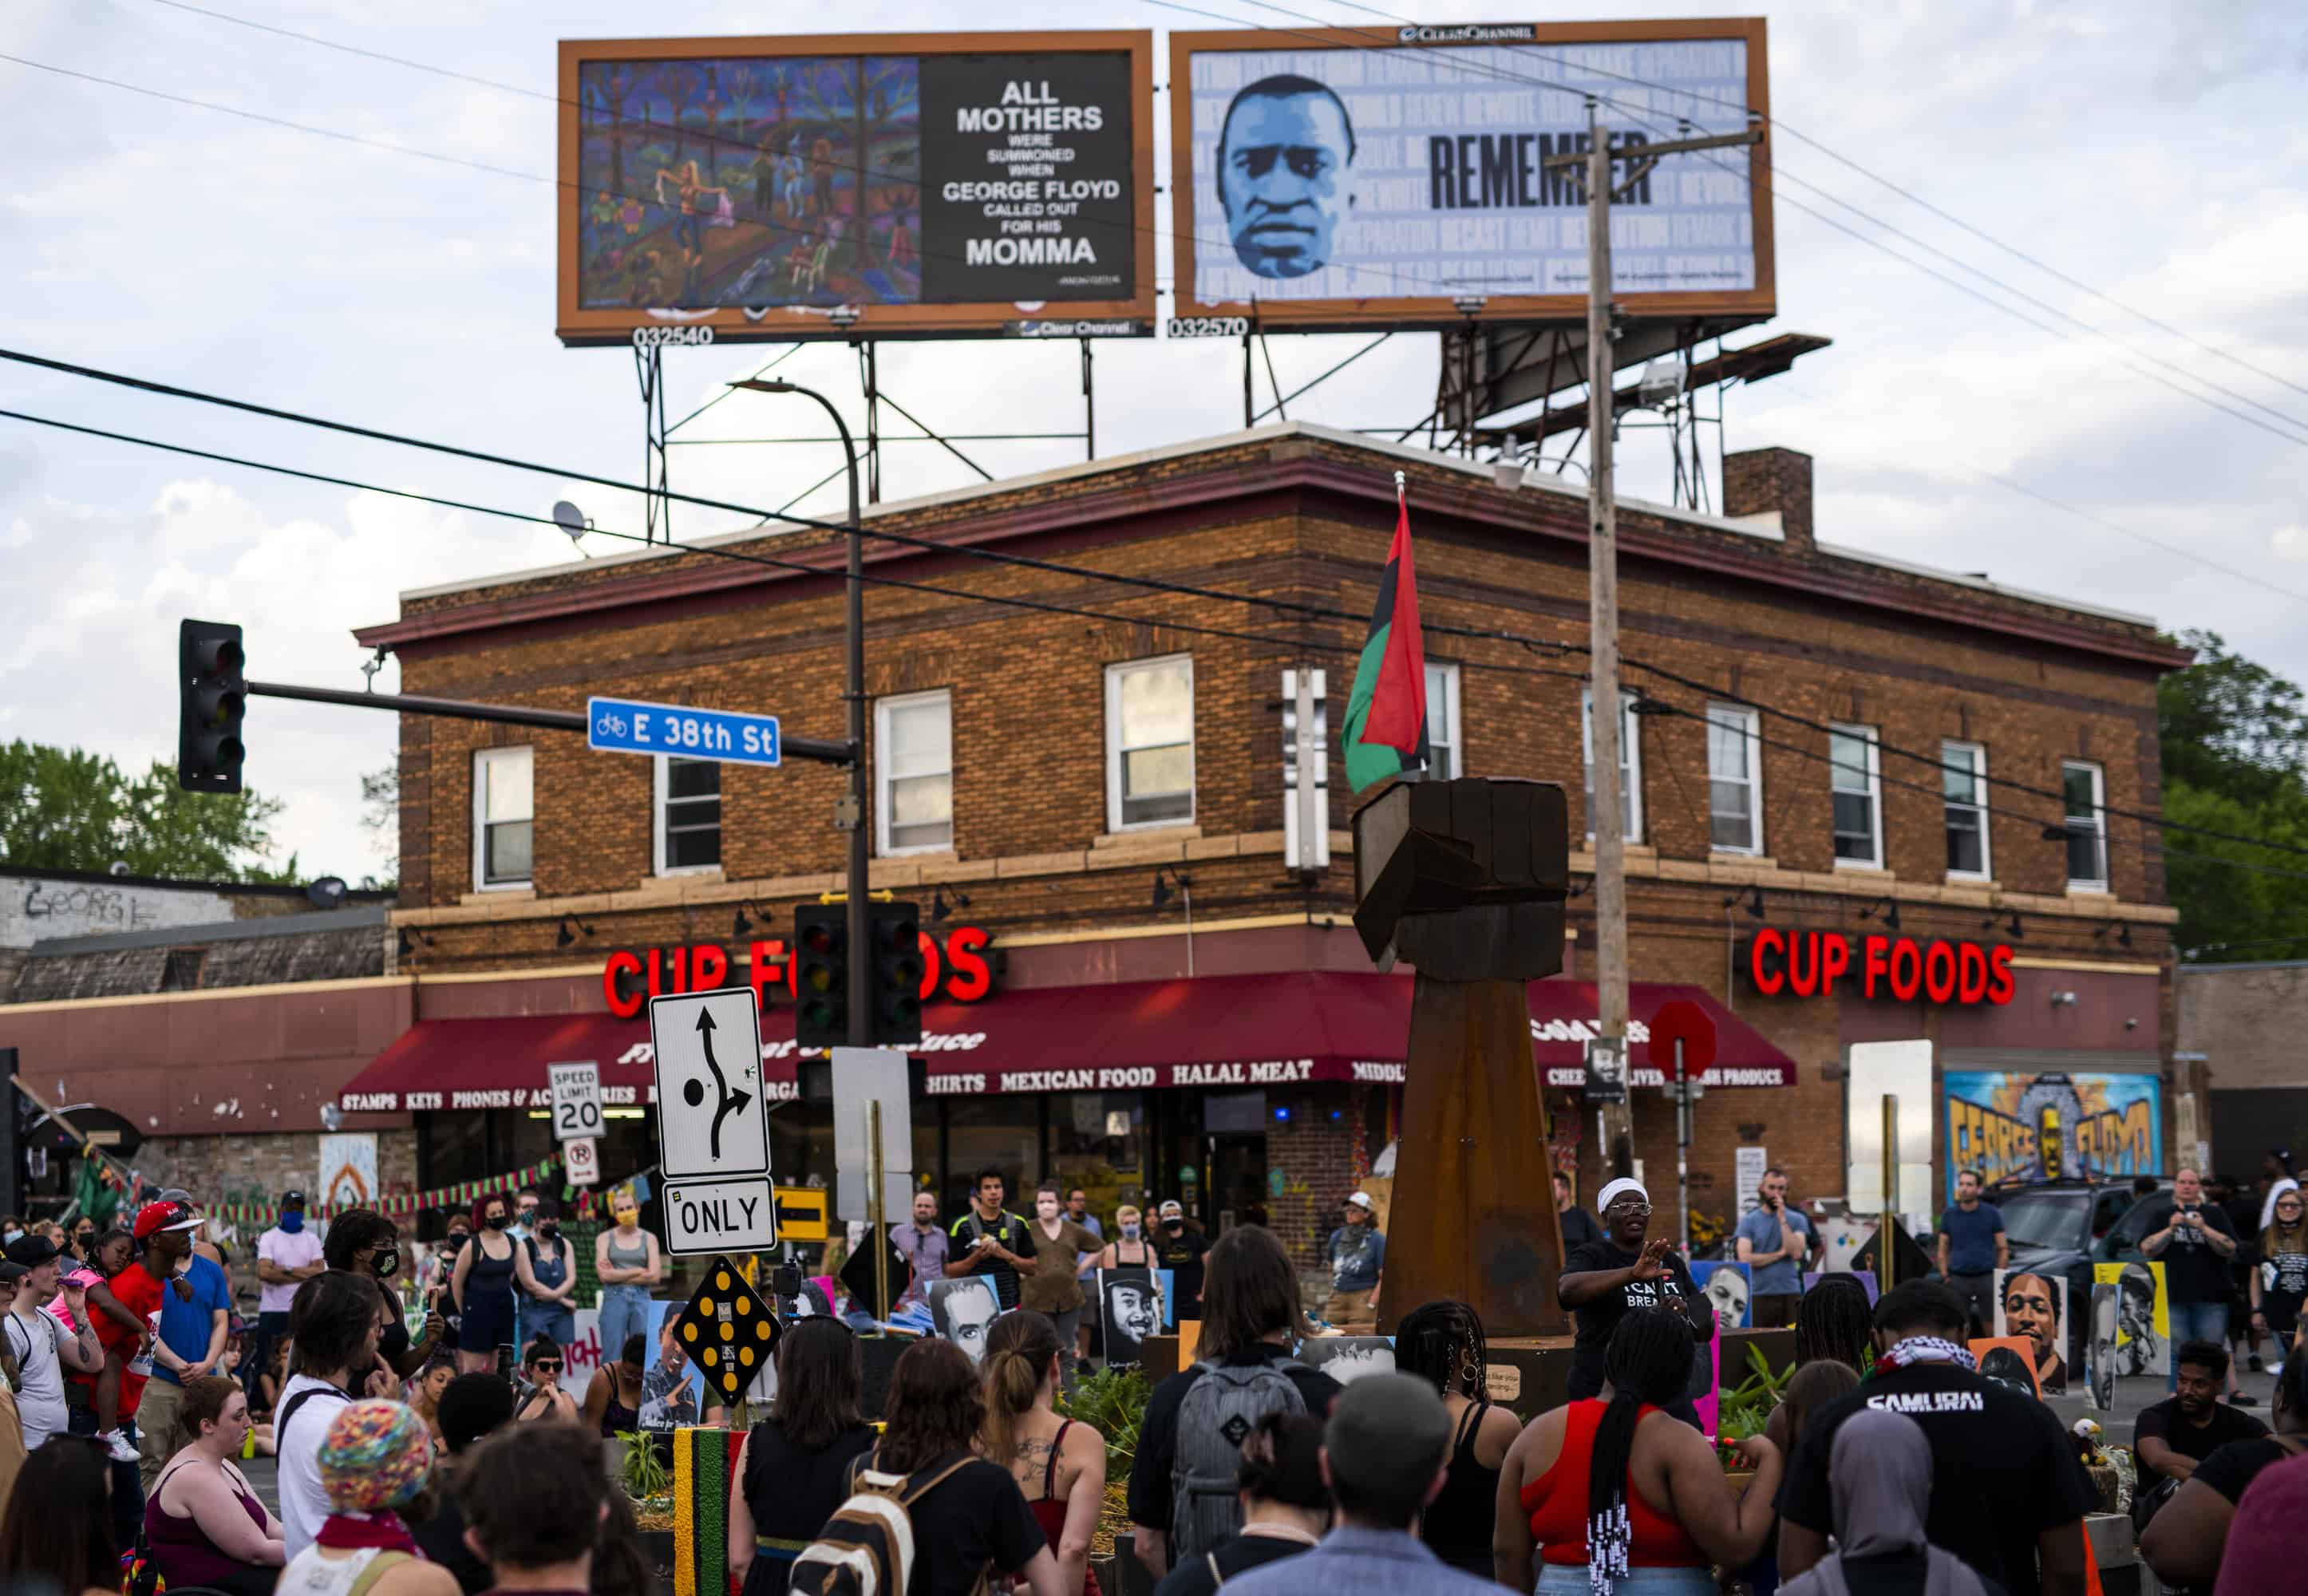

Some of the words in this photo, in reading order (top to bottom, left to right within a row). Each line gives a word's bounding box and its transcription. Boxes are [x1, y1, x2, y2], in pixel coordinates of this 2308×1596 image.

[1001, 81, 1059, 105] ALL
[958, 106, 1103, 132] MOTHERS
[943, 181, 1040, 200] GEORGE
[1045, 180, 1120, 200] FLOYD
[983, 203, 1044, 216] CALLED
[1046, 202, 1080, 215] OUT
[1001, 219, 1033, 234] FOR
[1036, 219, 1062, 233] HIS
[966, 237, 1097, 266] MOMMA
[633, 326, 714, 346] 032540
[1168, 317, 1249, 337] 032570
[634, 713, 651, 743] E
[664, 716, 731, 752] 38th
[742, 725, 773, 755] St
[1751, 926, 1849, 997] CUP
[1864, 934, 2016, 1005] FOODS
[554, 1070, 595, 1085] SPEED
[1000, 1069, 1095, 1092] MEXICAN
[1098, 1066, 1156, 1088] FOOD
[1172, 1063, 1245, 1084] HALAL
[1250, 1059, 1314, 1082] MEAT
[342, 1092, 397, 1111] STAMPS
[405, 1091, 443, 1109] KEYS
[453, 1089, 511, 1108] PHONES
[560, 1086, 591, 1100] LIMIT
[559, 1102, 599, 1129] 20
[682, 1197, 758, 1234] ONLY
[1867, 1392, 1984, 1412] SAMURAI
